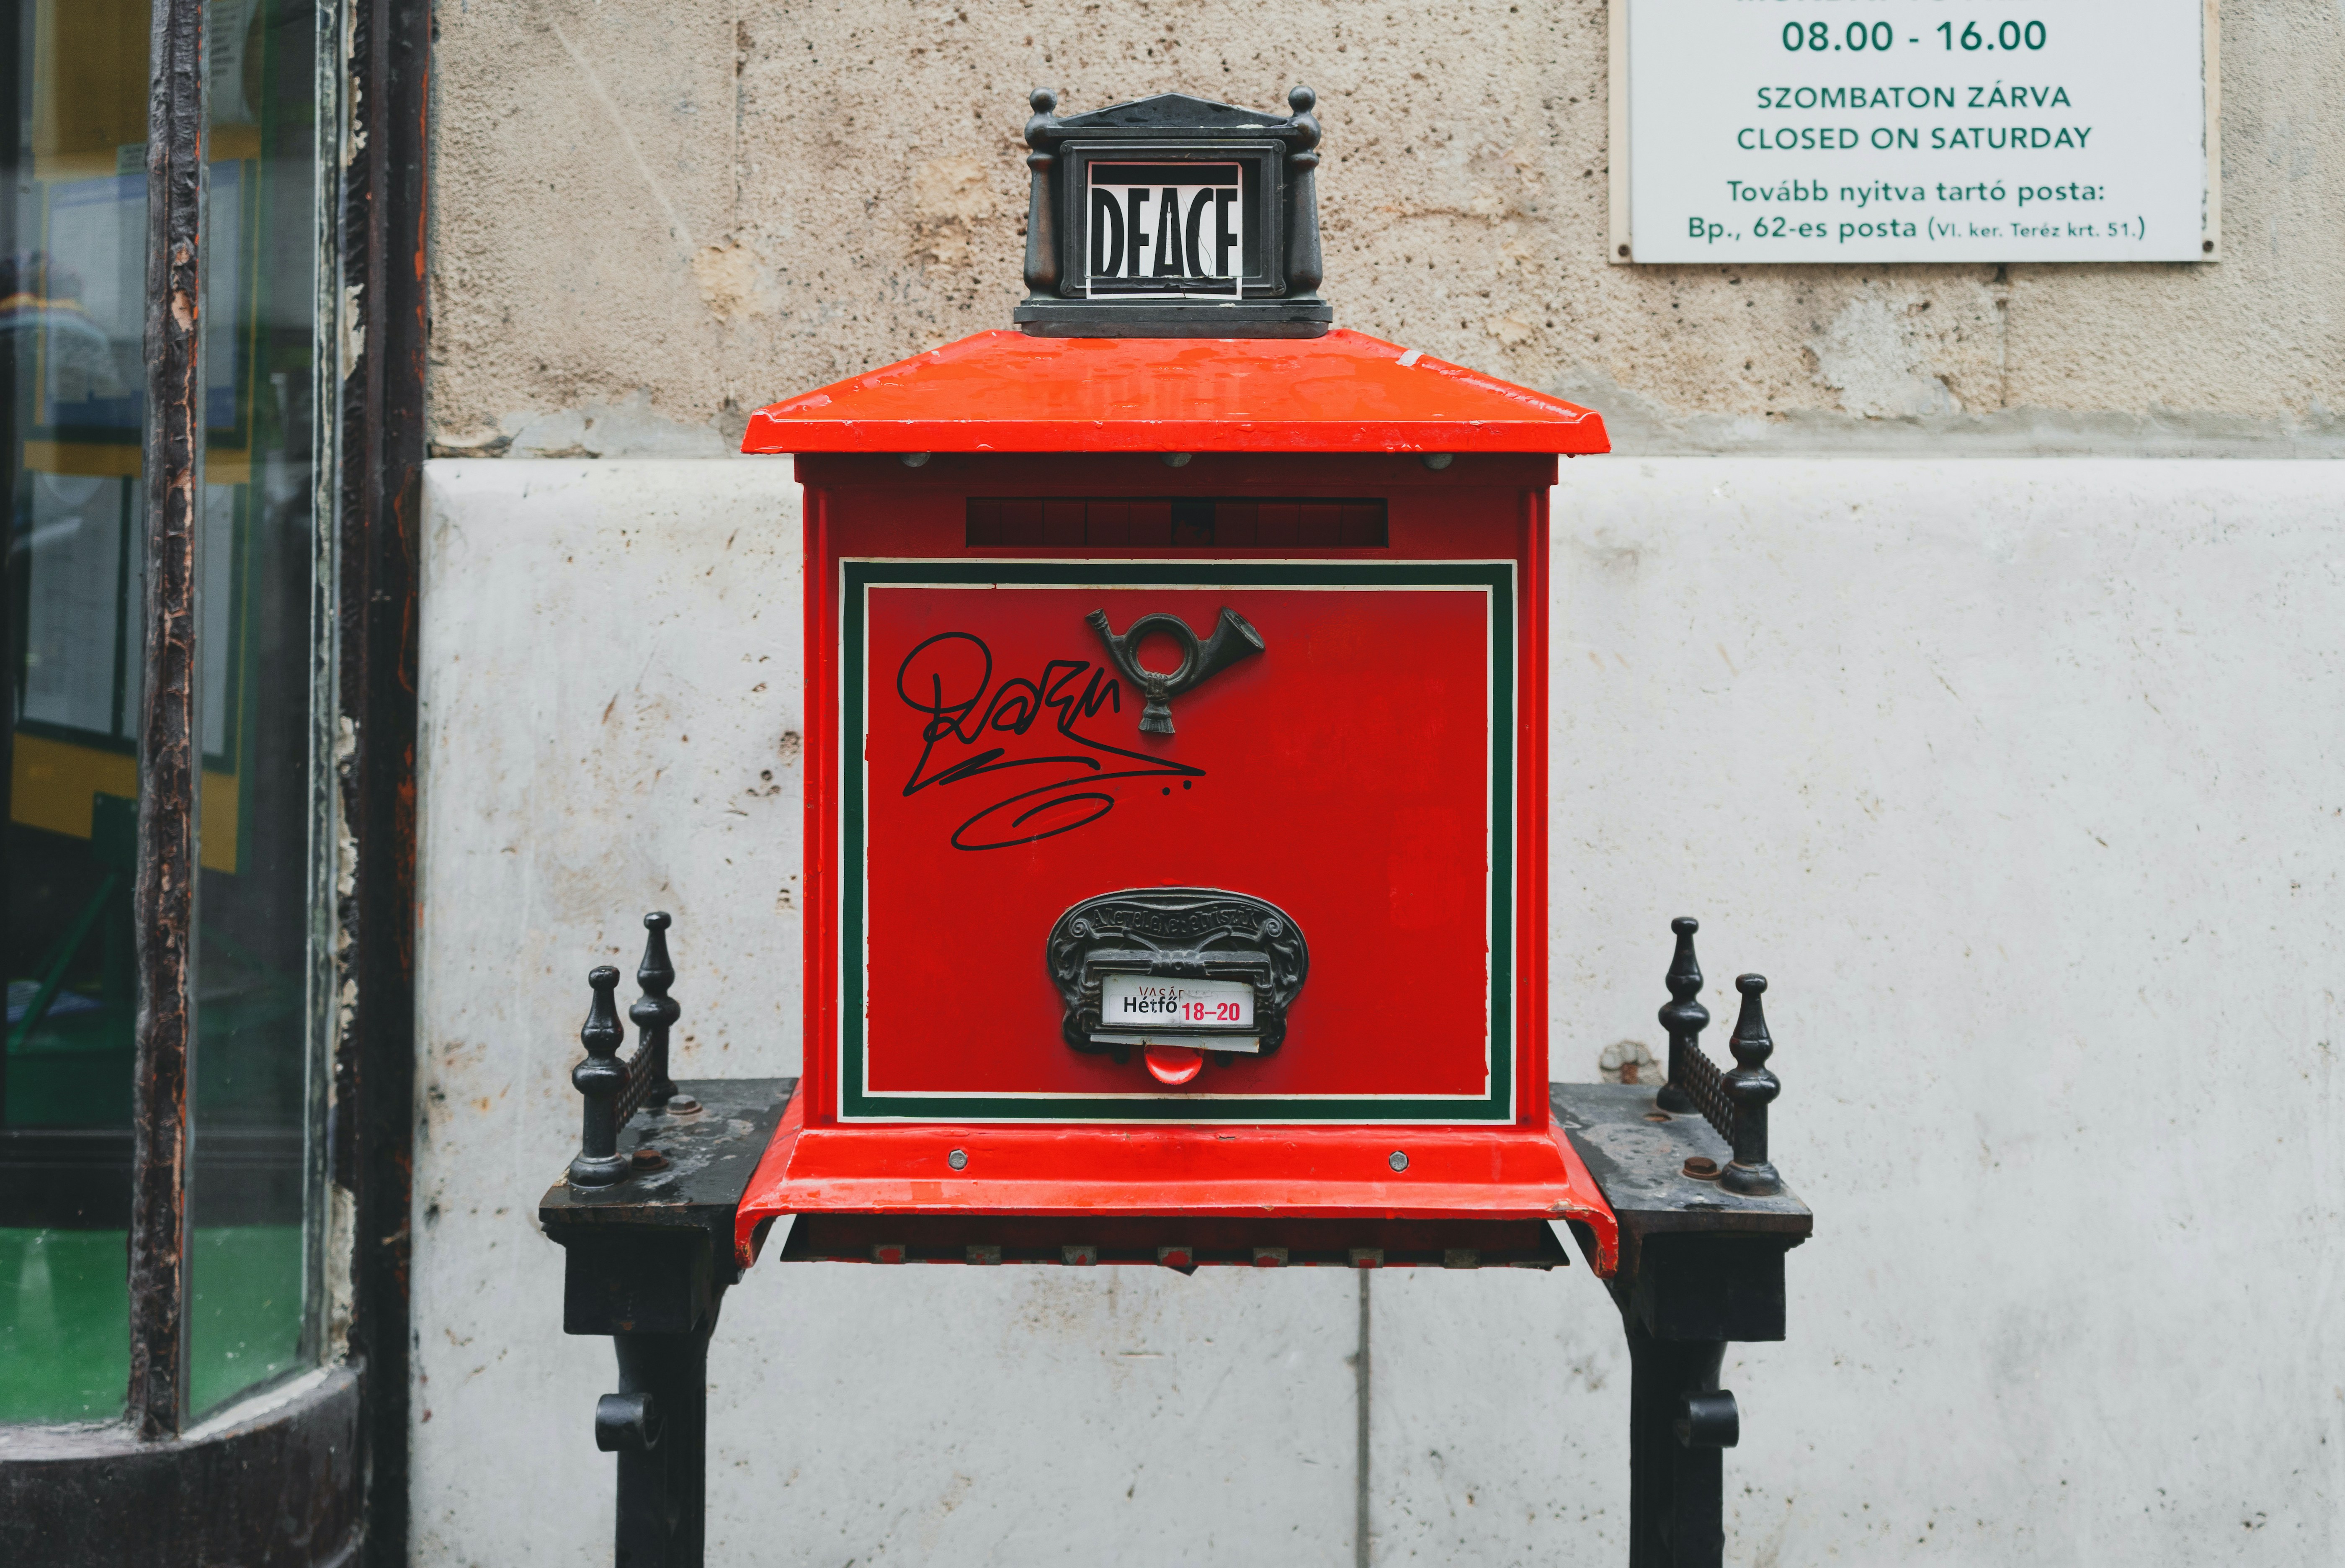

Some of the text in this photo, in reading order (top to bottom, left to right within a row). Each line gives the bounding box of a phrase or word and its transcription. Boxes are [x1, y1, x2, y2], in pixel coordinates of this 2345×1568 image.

[1782, 21, 1894, 52] 08.00
[1936, 20, 2047, 51] 16.00
[1757, 80, 2072, 109] SZOMBATON ZÁRVA
[1737, 126, 2092, 150] CLOSED ON SATURDAY
[1726, 179, 2105, 209] Tovább nyitva tartó posta:
[1688, 215, 2146, 245] Bp., 62-es posta (VI. ker. Teréz krt. 51.)
[1124, 996, 1178, 1013] Hétfő
